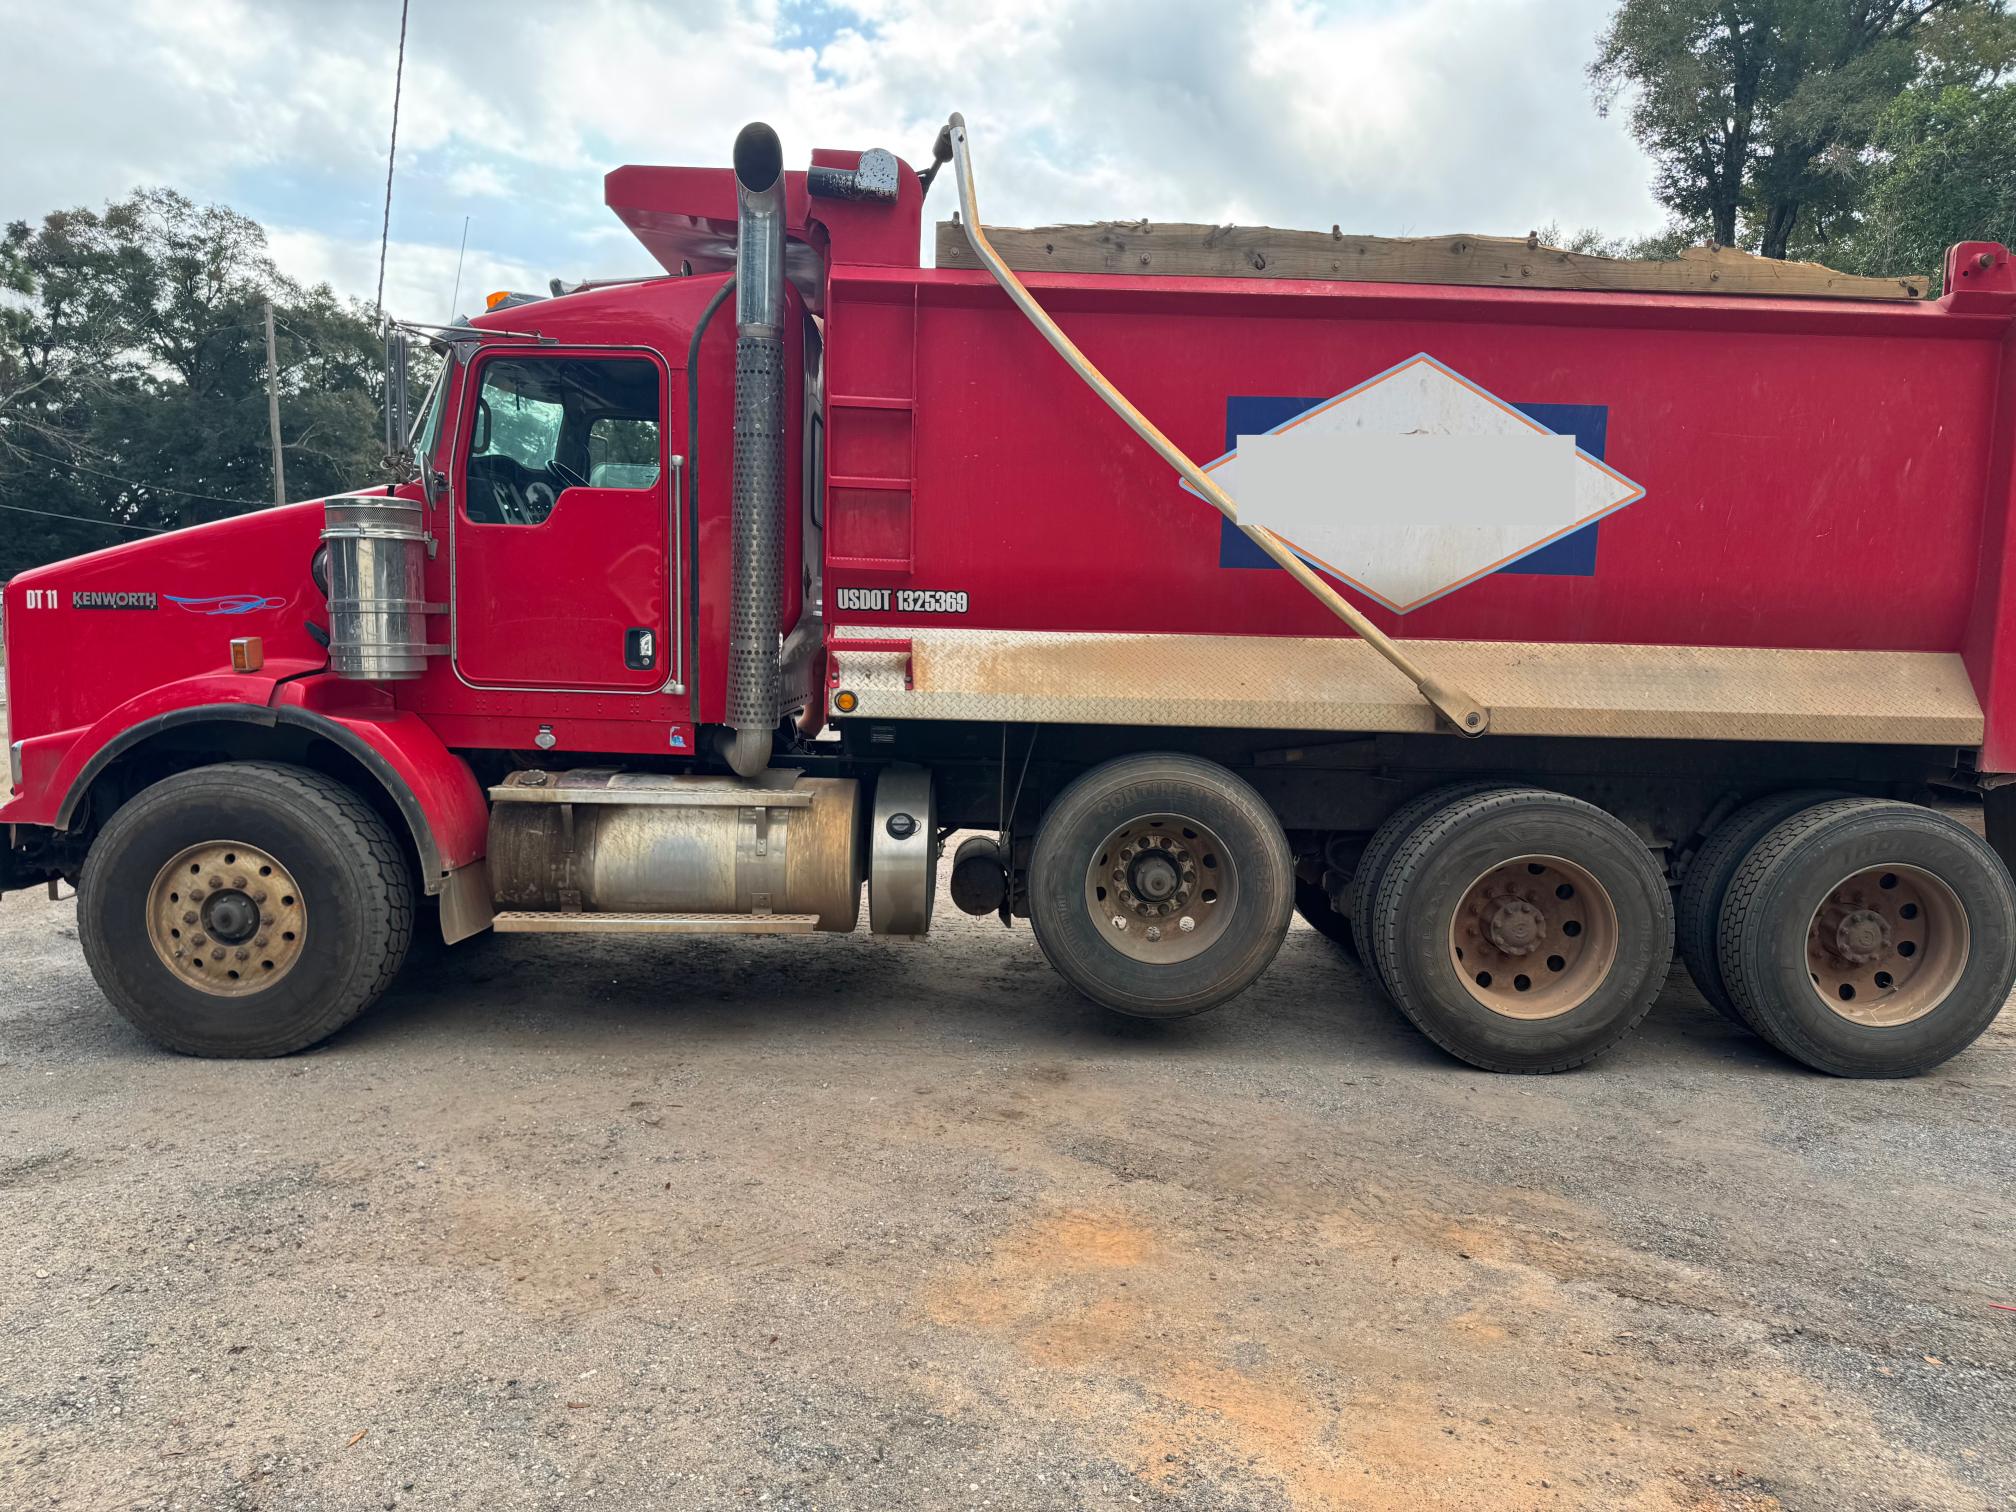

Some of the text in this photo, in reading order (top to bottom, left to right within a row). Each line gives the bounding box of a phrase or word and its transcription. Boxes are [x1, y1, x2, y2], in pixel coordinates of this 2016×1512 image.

[26, 589, 58, 609] DT 11
[72, 591, 157, 606] KENWORTH
[837, 588, 968, 613] USDOT 1325369
